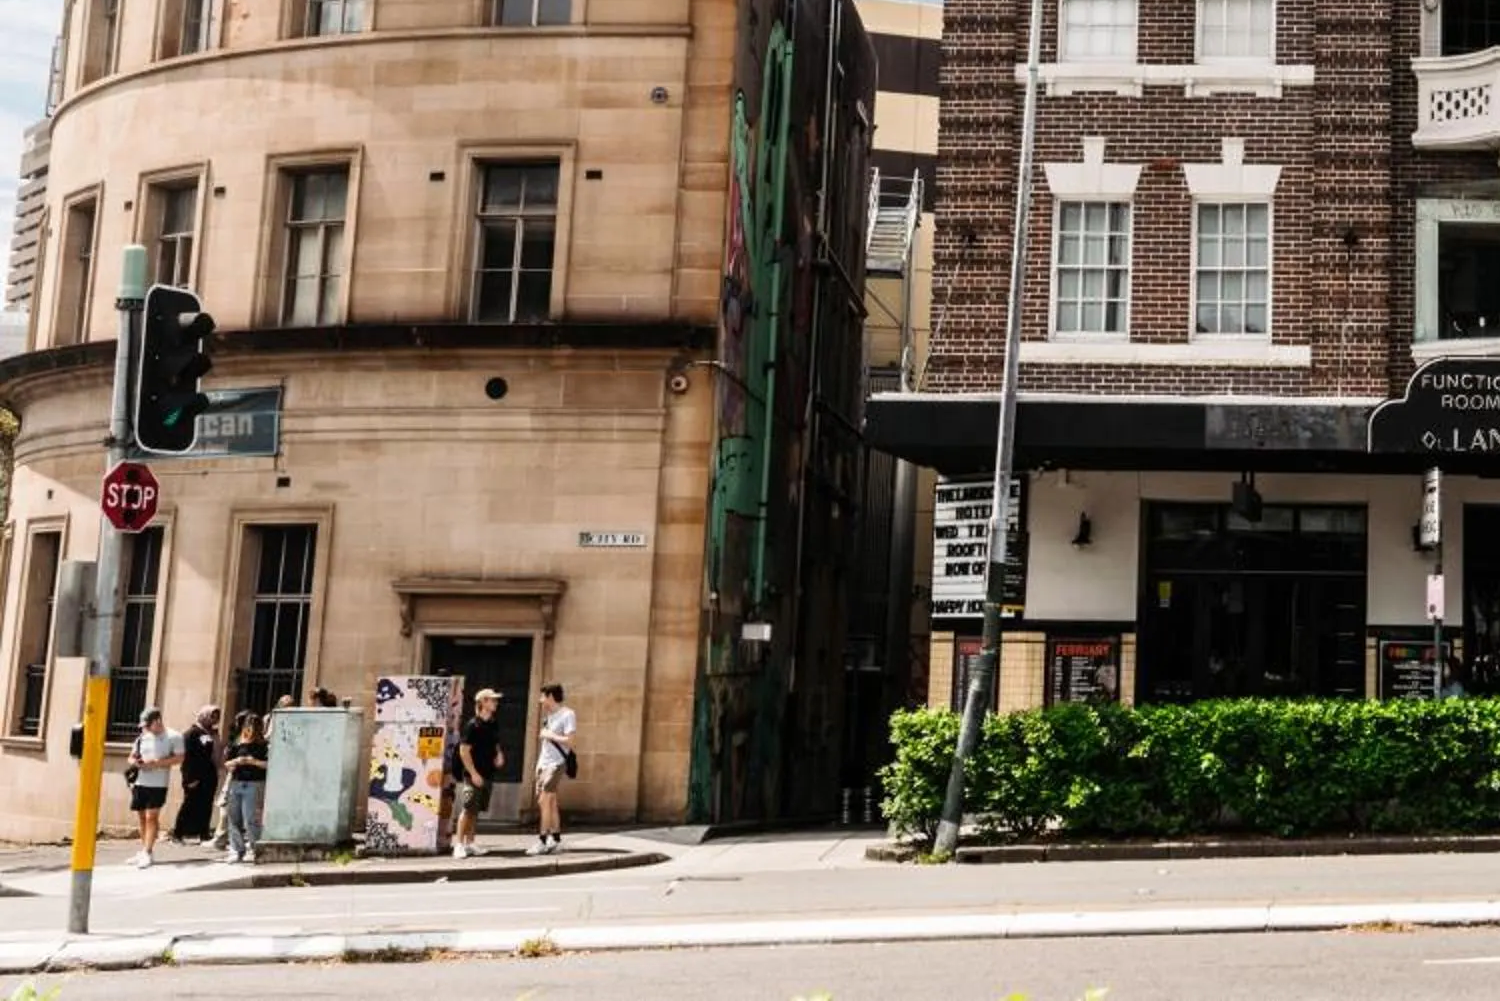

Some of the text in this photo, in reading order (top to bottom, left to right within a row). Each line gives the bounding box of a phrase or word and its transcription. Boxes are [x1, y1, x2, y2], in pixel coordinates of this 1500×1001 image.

[1441, 394, 1500, 410] ROOM
[107, 482, 155, 510] STOP
[946, 542, 988, 557] ROOFT
